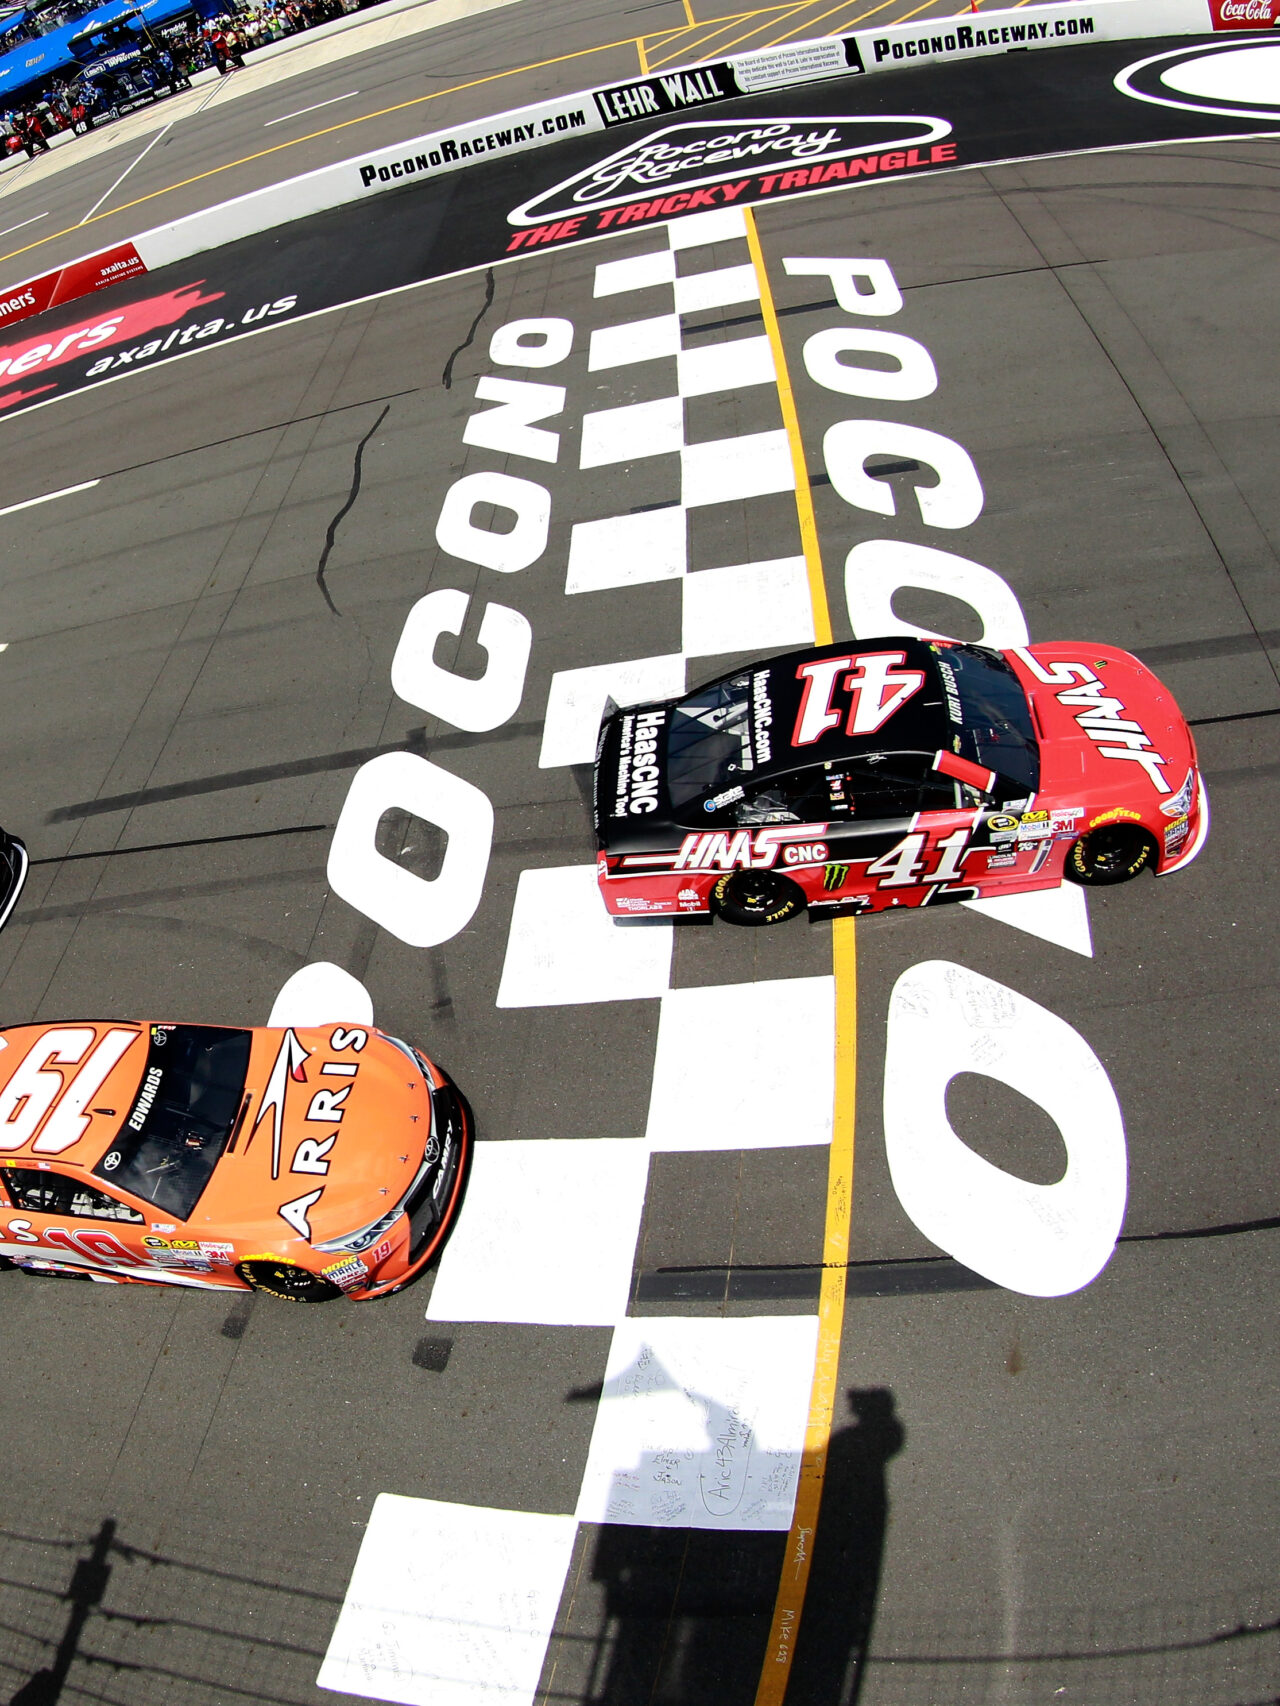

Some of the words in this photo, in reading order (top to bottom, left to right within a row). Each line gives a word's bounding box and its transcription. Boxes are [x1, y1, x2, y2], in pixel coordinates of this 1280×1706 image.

[1220, 0, 1271, 20] Coca-Cola
[596, 85, 660, 124] LEHR
[660, 68, 724, 108] WALL
[588, 128, 841, 186] Raceway
[630, 124, 792, 165] Pocono
[506, 216, 589, 252] THE
[597, 178, 750, 229] TRICKY
[757, 144, 958, 194] TRIANGLE
[101, 256, 140, 276] axalta.us
[85, 294, 298, 377] axalta.us
[792, 651, 926, 748] 41
[938, 661, 959, 696] BUSCH
[753, 669, 772, 764] HaasCNC.com
[946, 694, 963, 725] KURT
[1016, 646, 1172, 794] HAAS
[619, 714, 635, 756] America's
[616, 756, 632, 795] Machine
[629, 710, 666, 815] HaasCNC
[783, 258, 1128, 1297] POCOO
[1052, 819, 1073, 832] 3M
[1089, 807, 1142, 828] GOODYEAR
[672, 824, 827, 870] HAAS
[781, 842, 829, 864] CNC
[865, 828, 976, 889] 41
[1127, 845, 1150, 875] EAGLE
[765, 901, 795, 922] EAGLE
[129, 1066, 163, 1132] EDWARDS
[277, 1026, 368, 1244] ARRIS
[433, 1119, 453, 1200] CAMRY
[43, 1227, 146, 1270] 19
[205, 1250, 228, 1260] 3M
[239, 1252, 296, 1265] GOODYEAR
[321, 1255, 358, 1275] MOOG
[328, 1260, 365, 1279] MAHLE
[372, 1240, 392, 1263] 19
